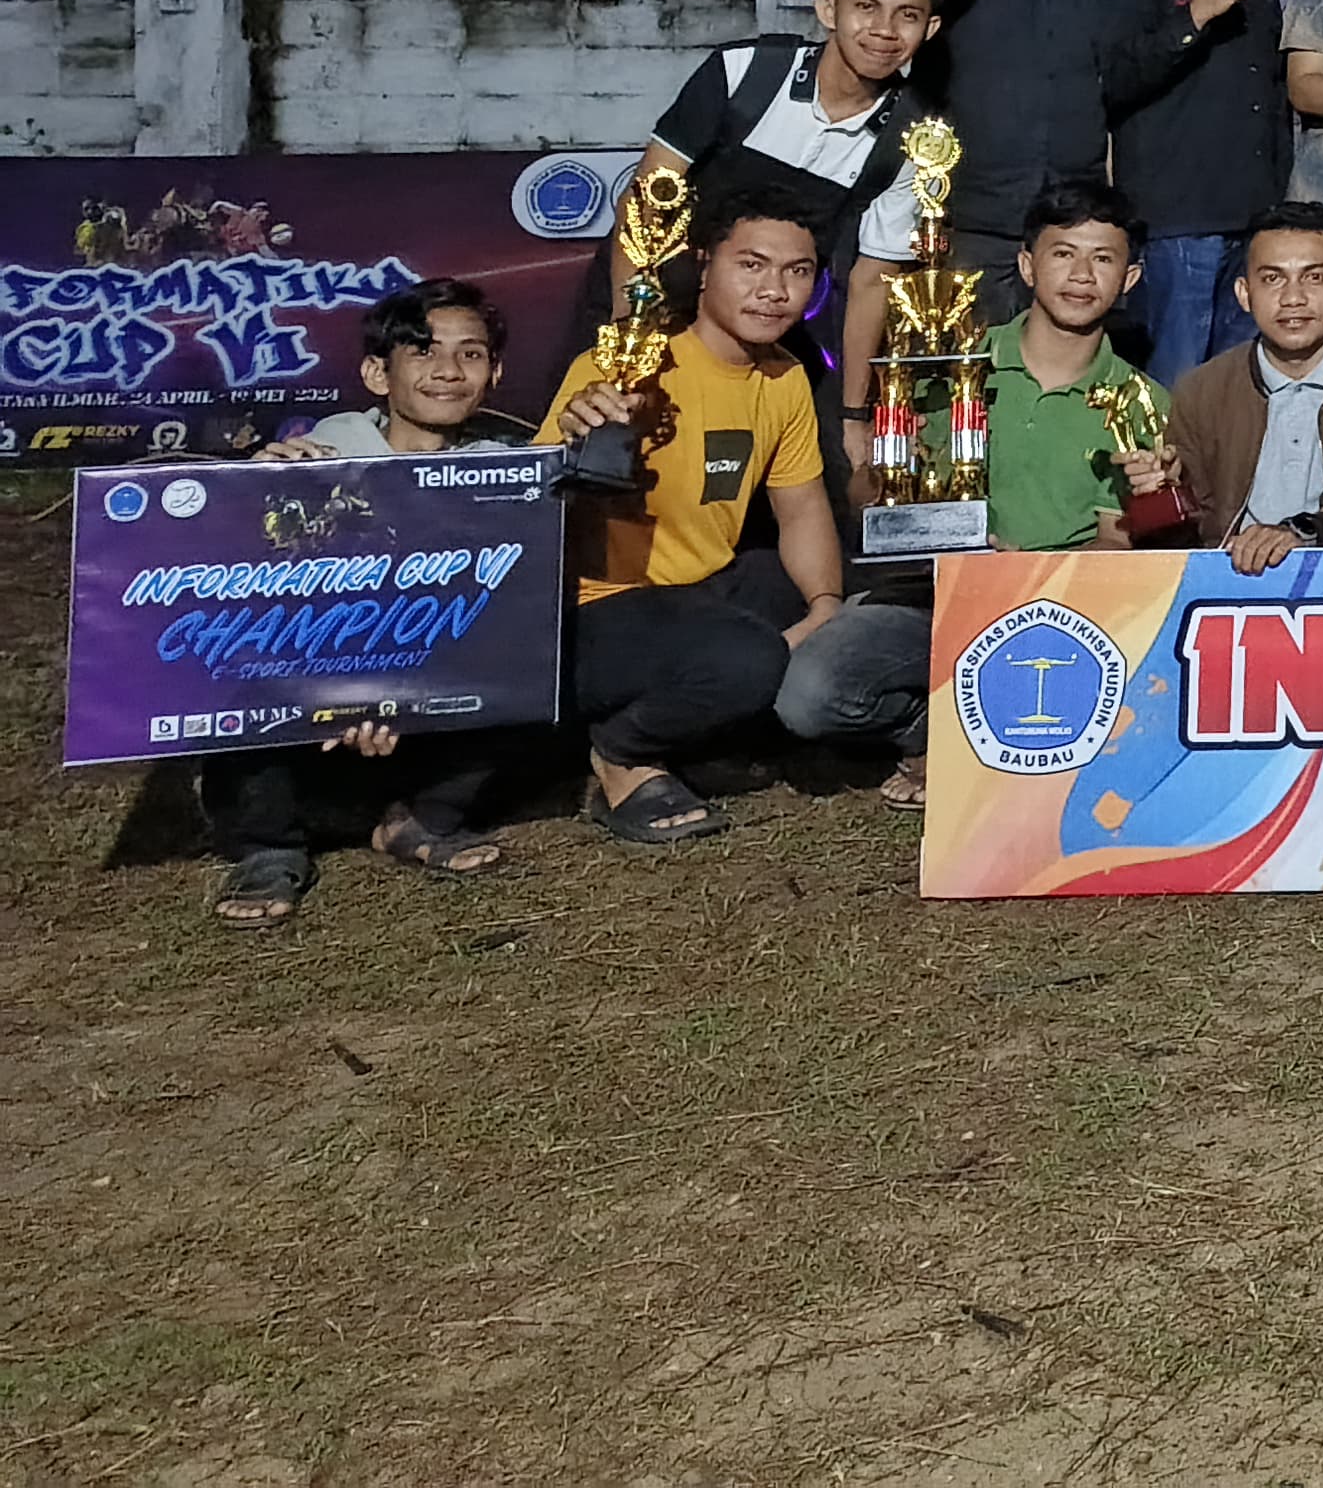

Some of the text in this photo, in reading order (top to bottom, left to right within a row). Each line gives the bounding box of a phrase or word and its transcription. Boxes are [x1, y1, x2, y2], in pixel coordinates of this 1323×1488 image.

[1, 317, 176, 389] CUP
[155, 390, 215, 404] APRIL
[254, 389, 286, 403] MEI
[294, 388, 339, 402] 2024
[413, 460, 542, 489] Telkomsel
[122, 543, 523, 606] INFORMATIKA CUP VI
[157, 588, 490, 668] CHAMPION
[302, 649, 432, 677] TOURNAMENT
[961, 606, 1119, 730] UNIVERSITAS DAYANU IKHSANUDDIN
[1000, 748, 1074, 767] BAUBAU
